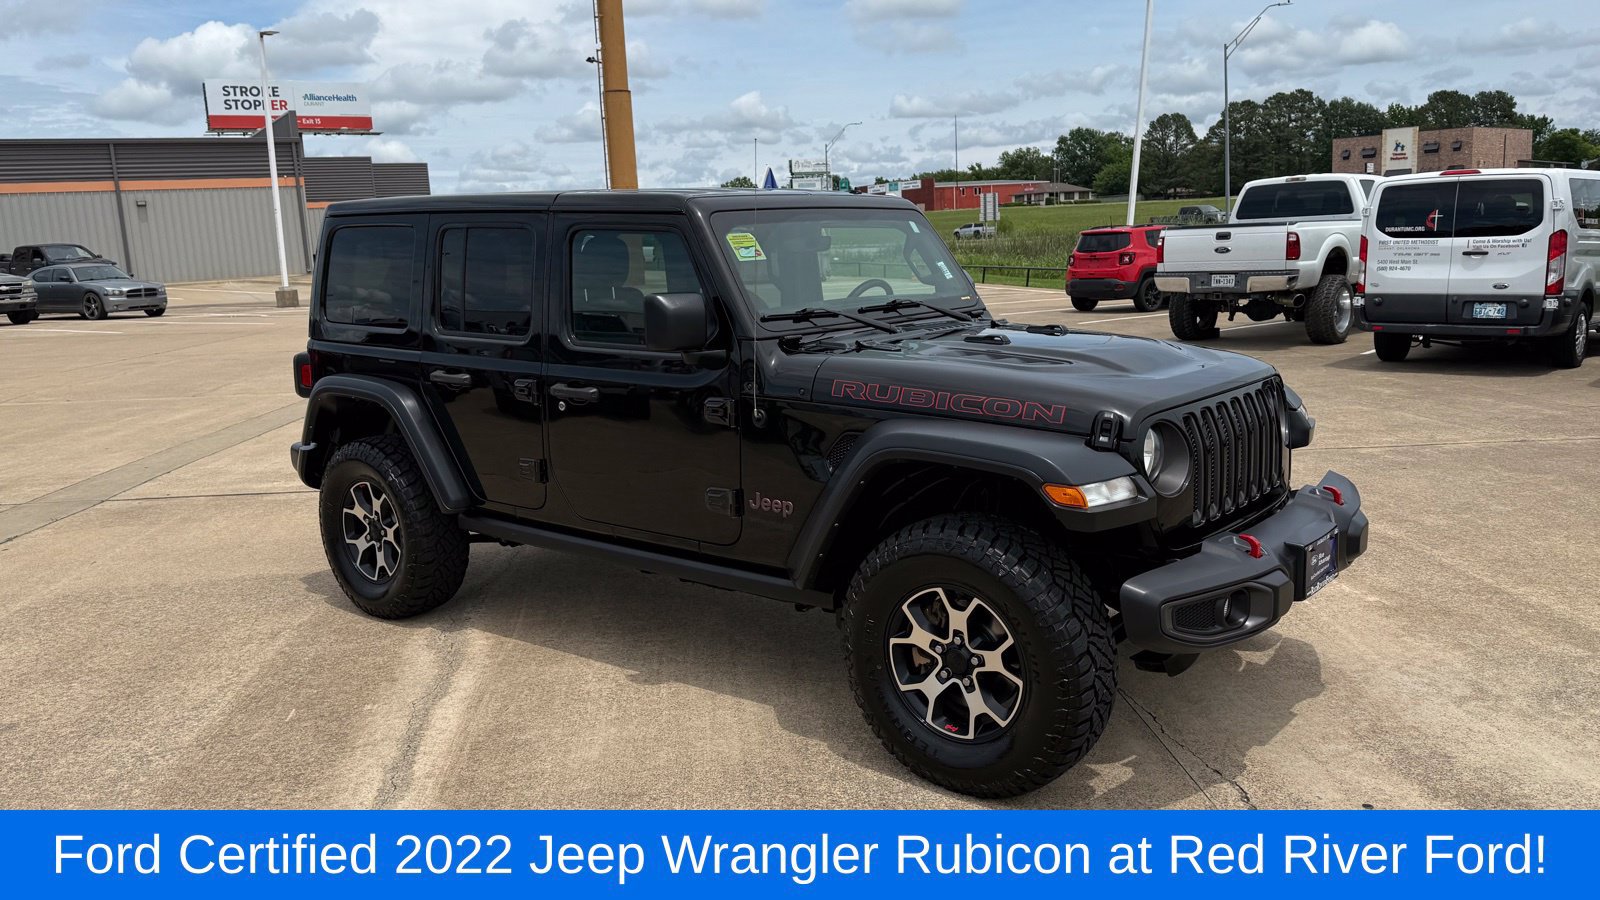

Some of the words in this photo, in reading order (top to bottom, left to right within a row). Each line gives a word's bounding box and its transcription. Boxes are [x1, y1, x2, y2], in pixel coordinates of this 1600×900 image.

[303, 93, 357, 102] AllianceHealth
[223, 98, 289, 111] STOPER
[302, 117, 314, 125] Exit
[314, 117, 321, 125] 15
[831, 379, 1066, 425] RUBICON
[749, 492, 794, 518] Jeep
